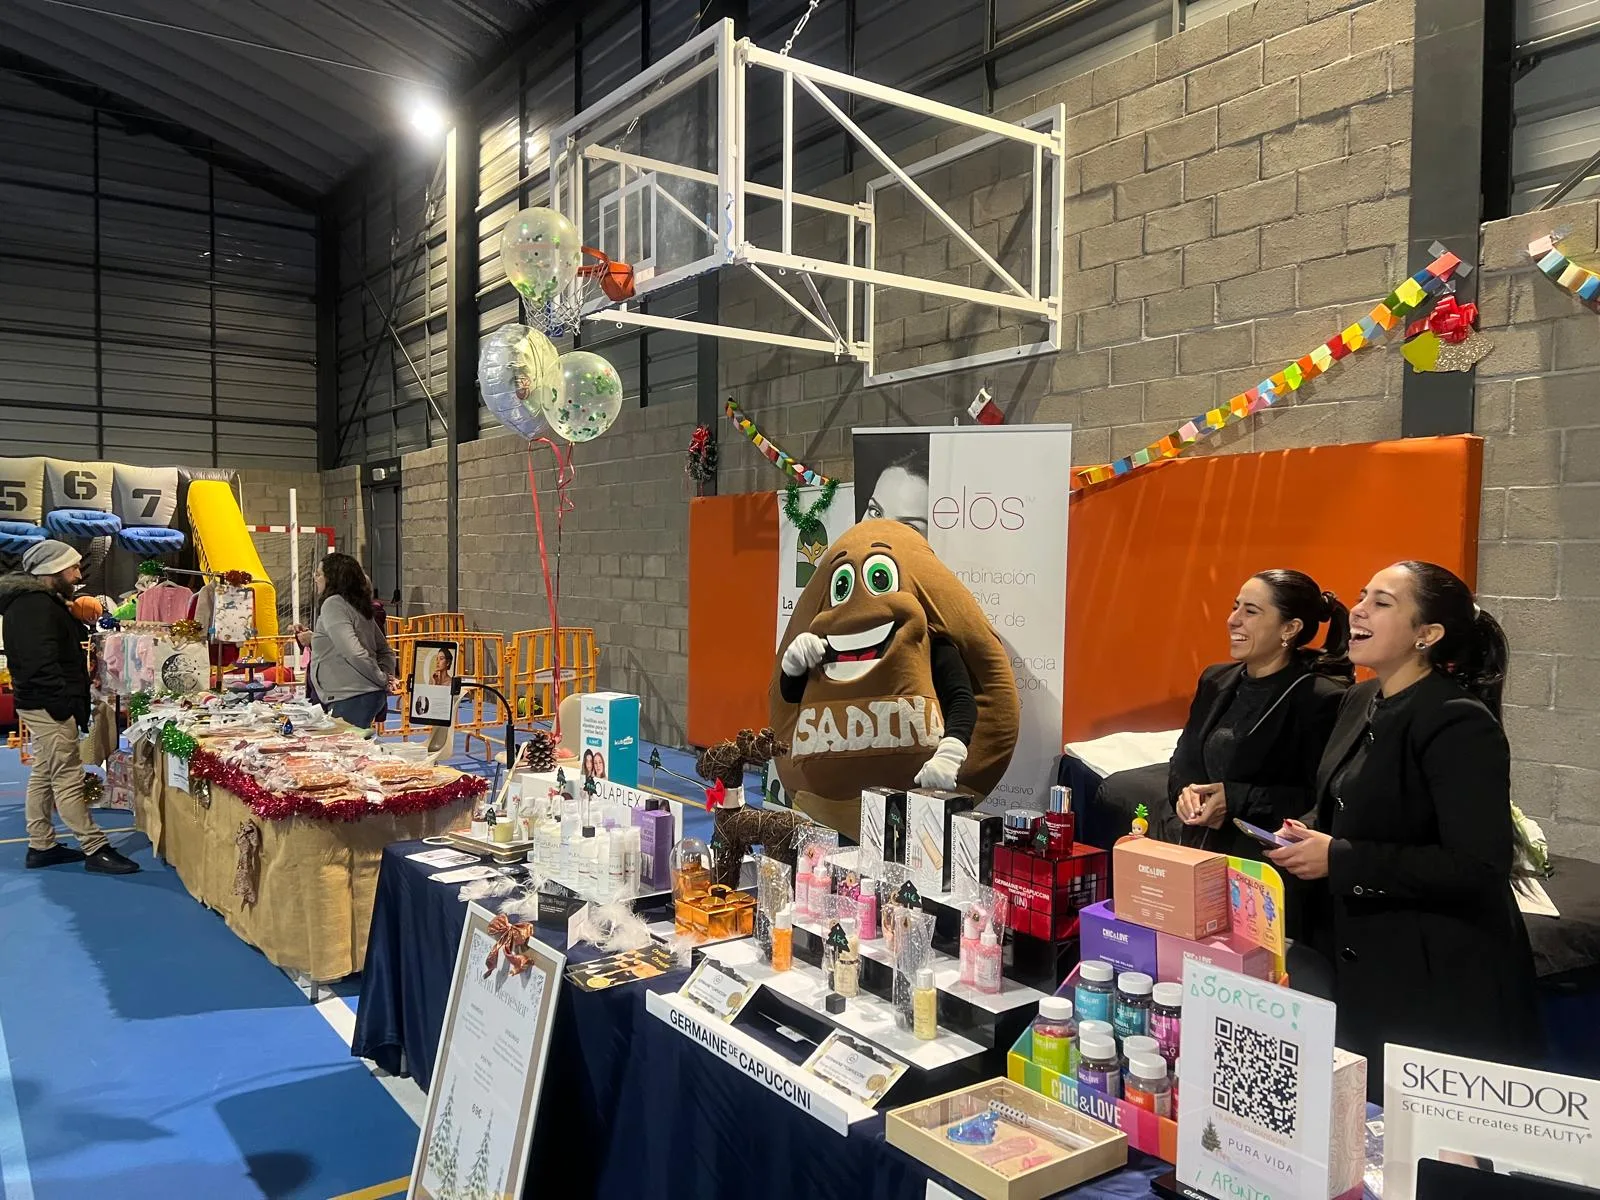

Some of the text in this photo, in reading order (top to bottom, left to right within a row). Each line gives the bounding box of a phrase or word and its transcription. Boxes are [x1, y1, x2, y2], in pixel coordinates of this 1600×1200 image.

[0, 481, 28, 511] 5
[64, 471, 97, 500] 6
[132, 488, 162, 518] 7
[953, 569, 1036, 585] mbinación
[783, 596, 793, 610] La
[972, 591, 1000, 606] siva
[987, 611, 1026, 628] er de
[1016, 675, 1047, 690] ción
[791, 696, 945, 759] SADINA
[595, 781, 642, 808] OLAPLEX
[995, 783, 1034, 796] xclusivo
[669, 1009, 728, 1058] GERMAINE
[728, 1043, 739, 1059] DE
[739, 1052, 811, 1111] CAPUCCINI
[1051, 1079, 1123, 1128] CHIC&LOVE
[1402, 1063, 1590, 1121] SKEYNDOR
[1402, 1100, 1465, 1122] SCIENCE
[1468, 1114, 1519, 1132] creates
[1228, 1137, 1260, 1160] PURA
[1264, 1153, 1293, 1176] VIDA
[1183, 1188, 1210, 1200] GER
